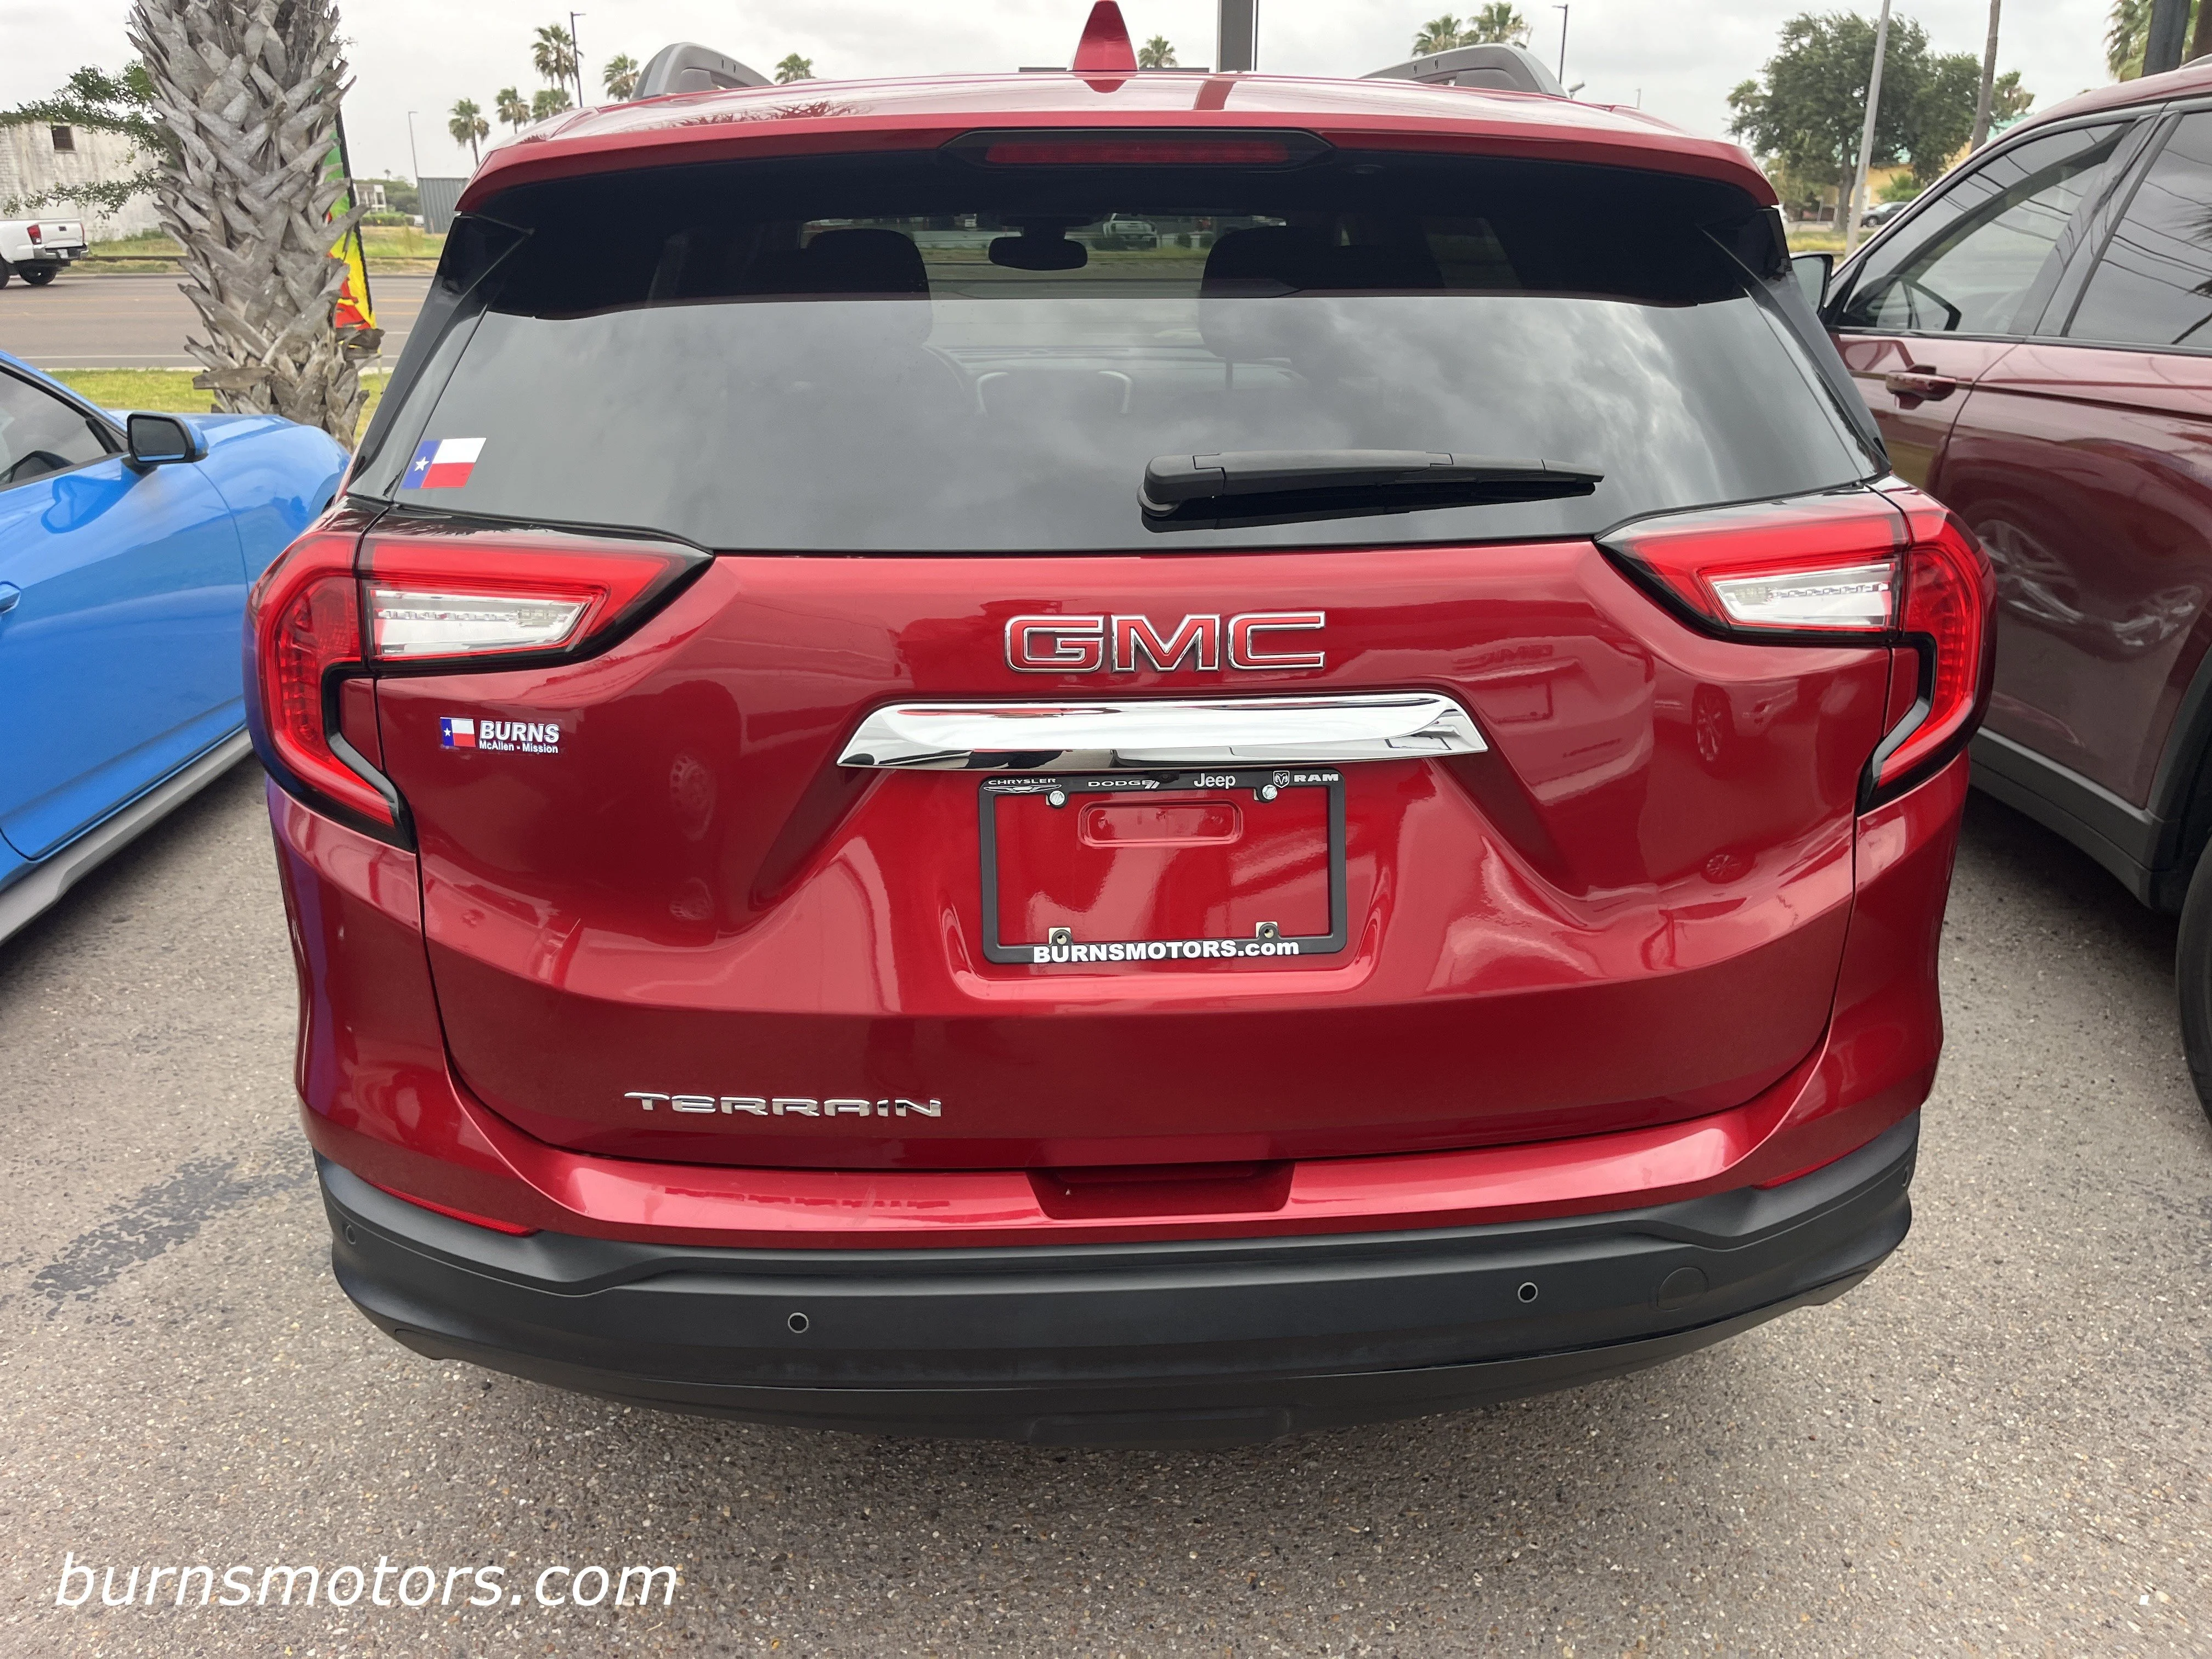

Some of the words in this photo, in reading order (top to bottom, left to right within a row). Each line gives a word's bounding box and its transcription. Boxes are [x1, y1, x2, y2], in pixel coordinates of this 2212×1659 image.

[1005, 611, 1325, 673] GMC
[479, 720, 560, 743] BURNS
[479, 741, 514, 751] McAllen
[522, 742, 558, 753] Mission
[1194, 773, 1236, 789] Jeep
[1294, 774, 1339, 782] RAM
[1033, 940, 1299, 963] BURNSMOTORS.com
[624, 1092, 941, 1117] TERRAIN
